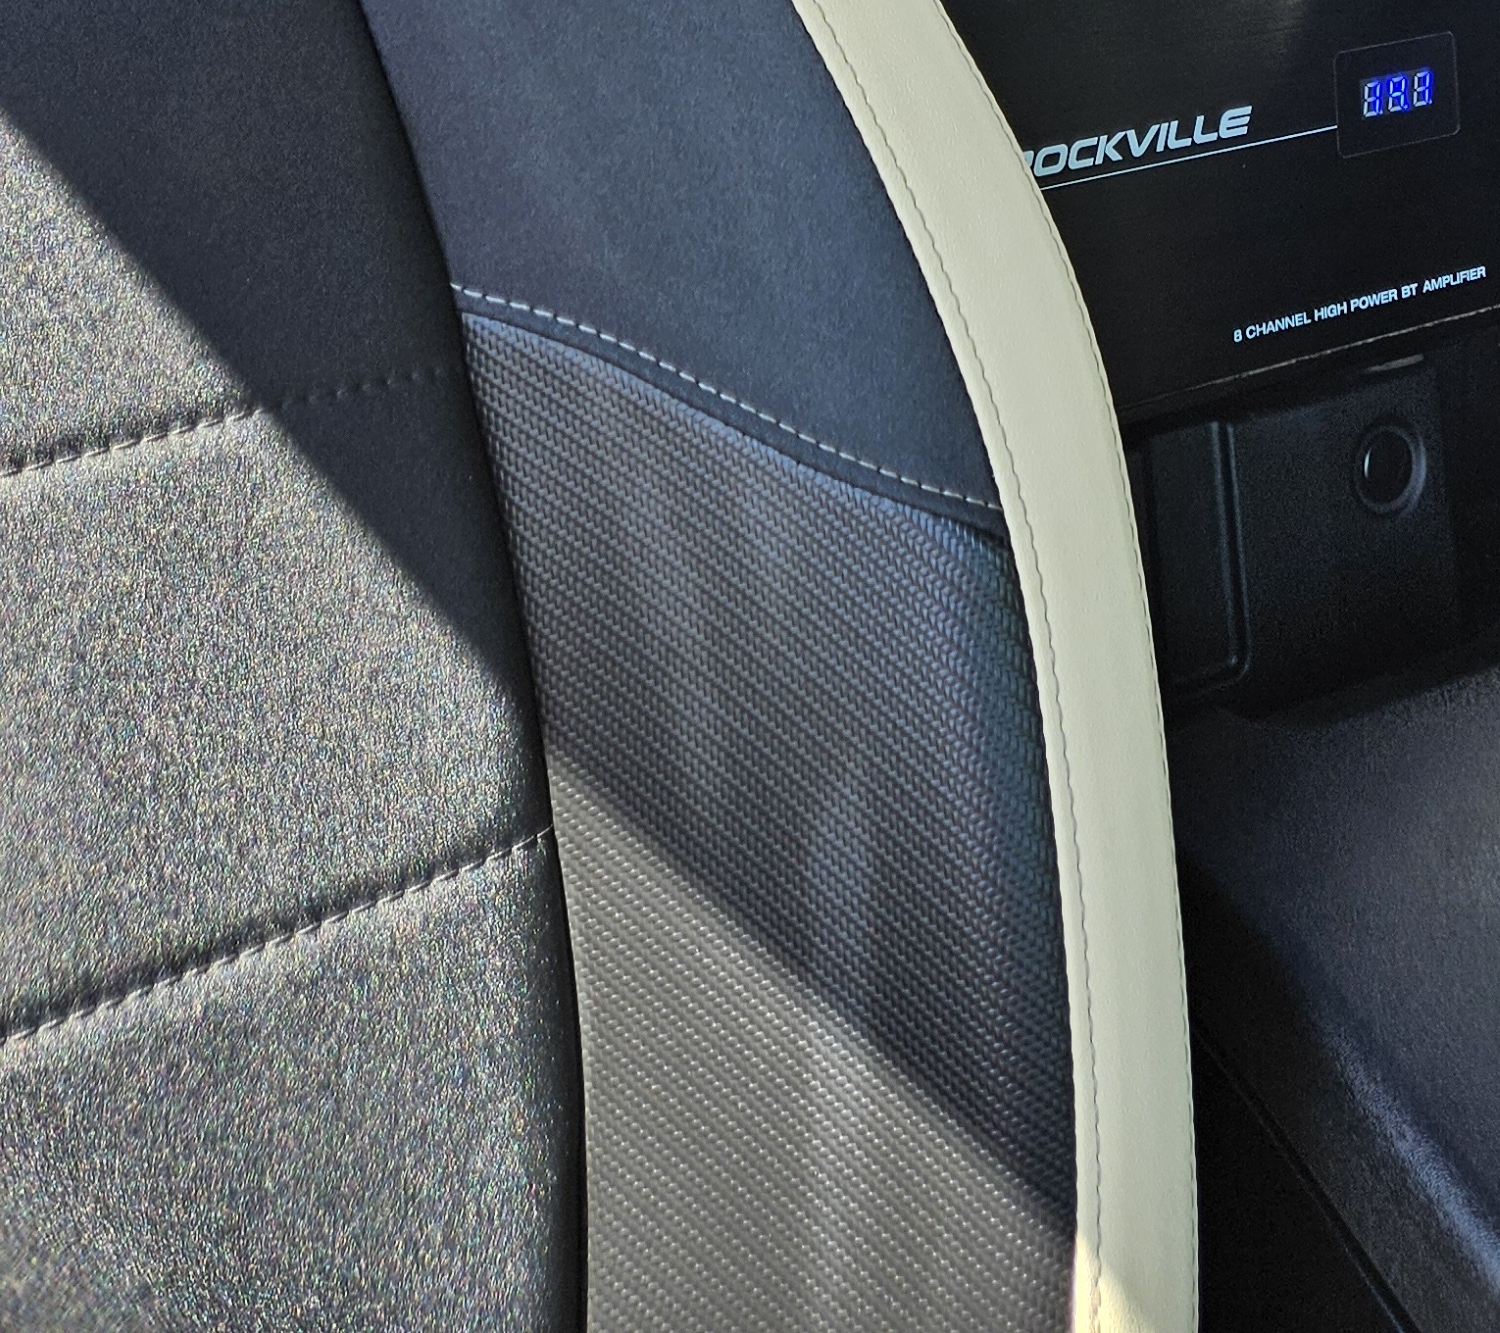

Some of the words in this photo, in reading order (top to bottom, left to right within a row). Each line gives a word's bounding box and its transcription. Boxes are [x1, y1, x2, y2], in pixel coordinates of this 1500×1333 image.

[1233, 329, 1243, 343] 8
[1245, 312, 1312, 339] CHANNEL
[1314, 302, 1348, 322] HIGH
[1350, 289, 1398, 312] POWER
[1401, 283, 1419, 299] BT
[1422, 265, 1487, 293] AMPLIFIER
